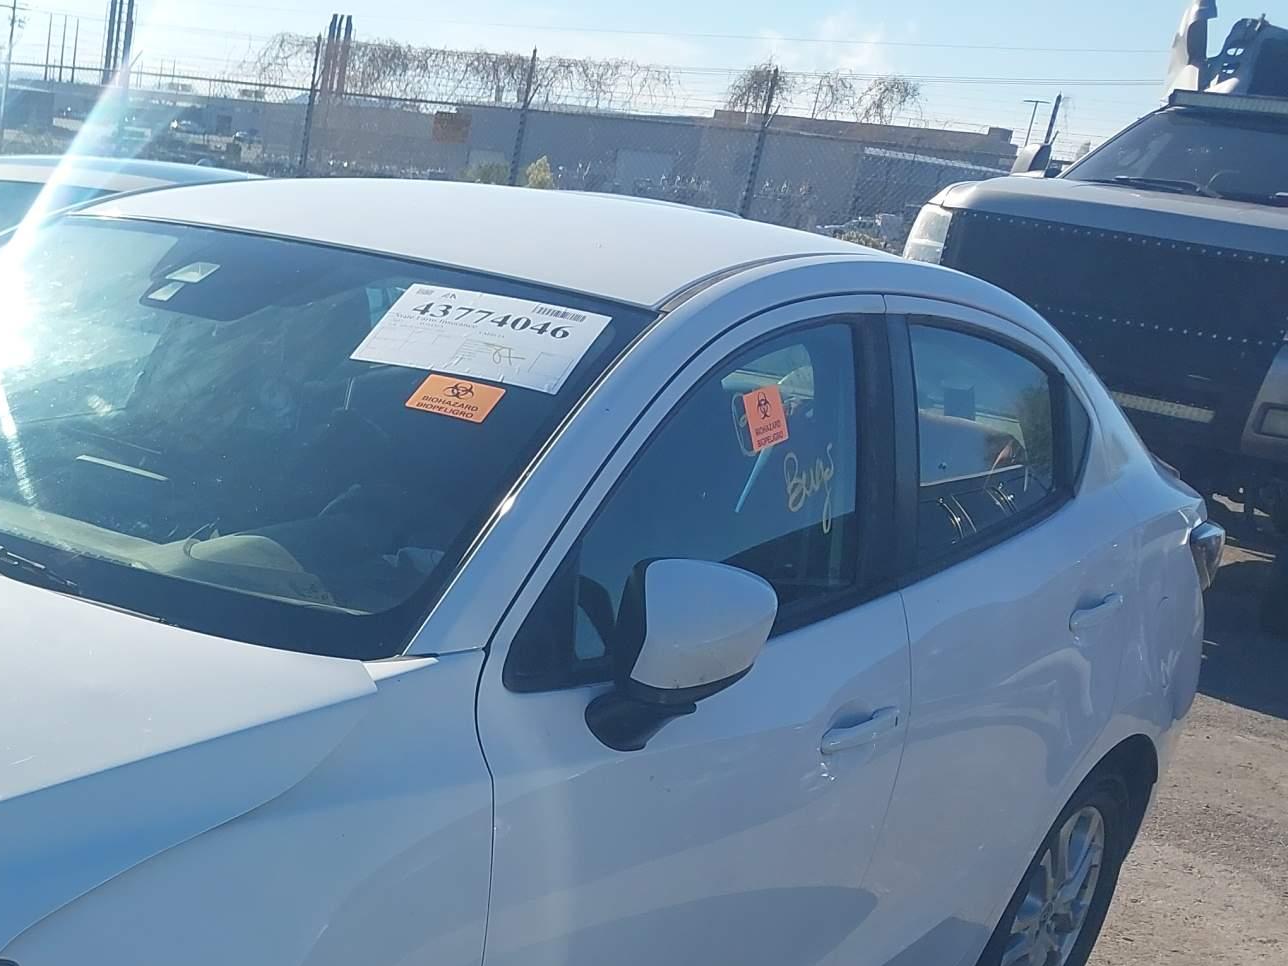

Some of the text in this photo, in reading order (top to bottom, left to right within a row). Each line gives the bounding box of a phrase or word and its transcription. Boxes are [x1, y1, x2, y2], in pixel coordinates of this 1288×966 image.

[412, 302, 575, 340] 43774046
[415, 401, 474, 419] BIOPELIGRO
[421, 395, 479, 412] BIOHAZARD
